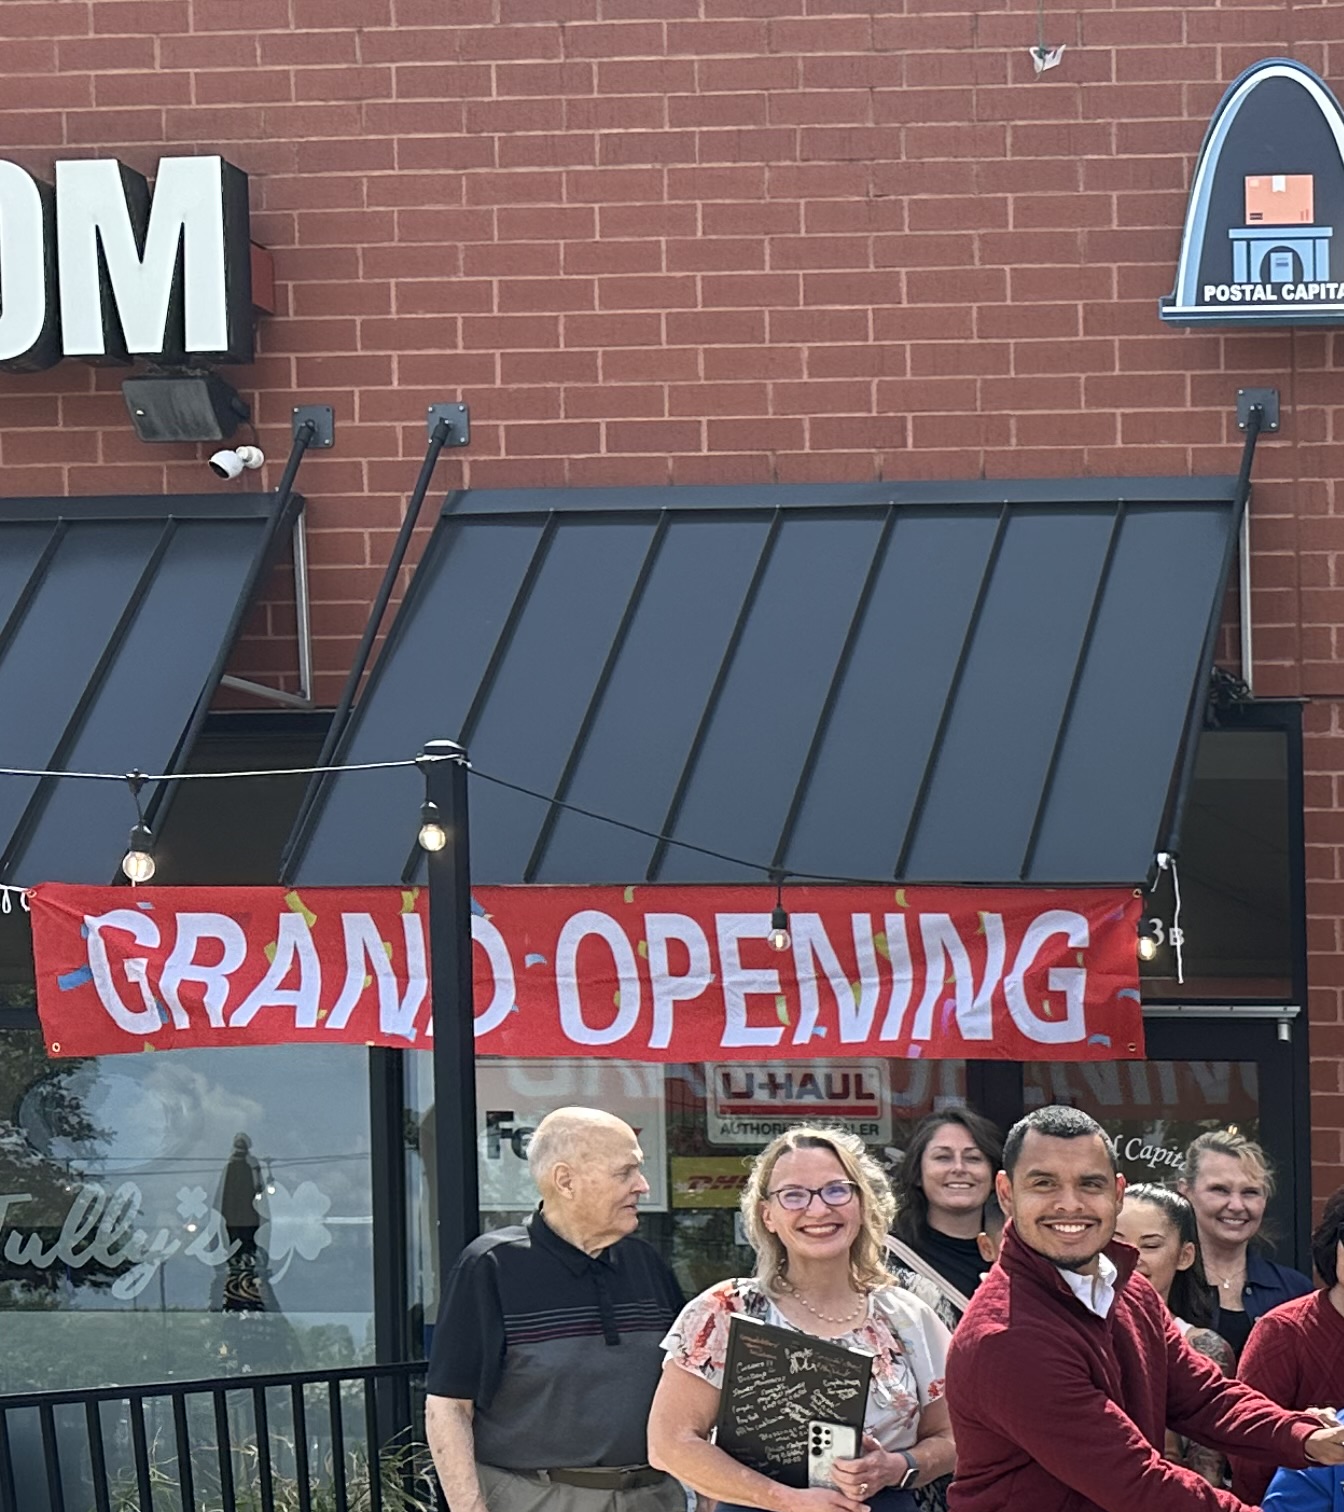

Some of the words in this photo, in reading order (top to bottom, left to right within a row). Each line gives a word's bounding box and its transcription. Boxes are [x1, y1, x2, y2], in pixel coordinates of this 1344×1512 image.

[1203, 283, 1277, 302] POSTAL
[554, 908, 1089, 1050] OPENING
[721, 1071, 876, 1101] U-HAUL
